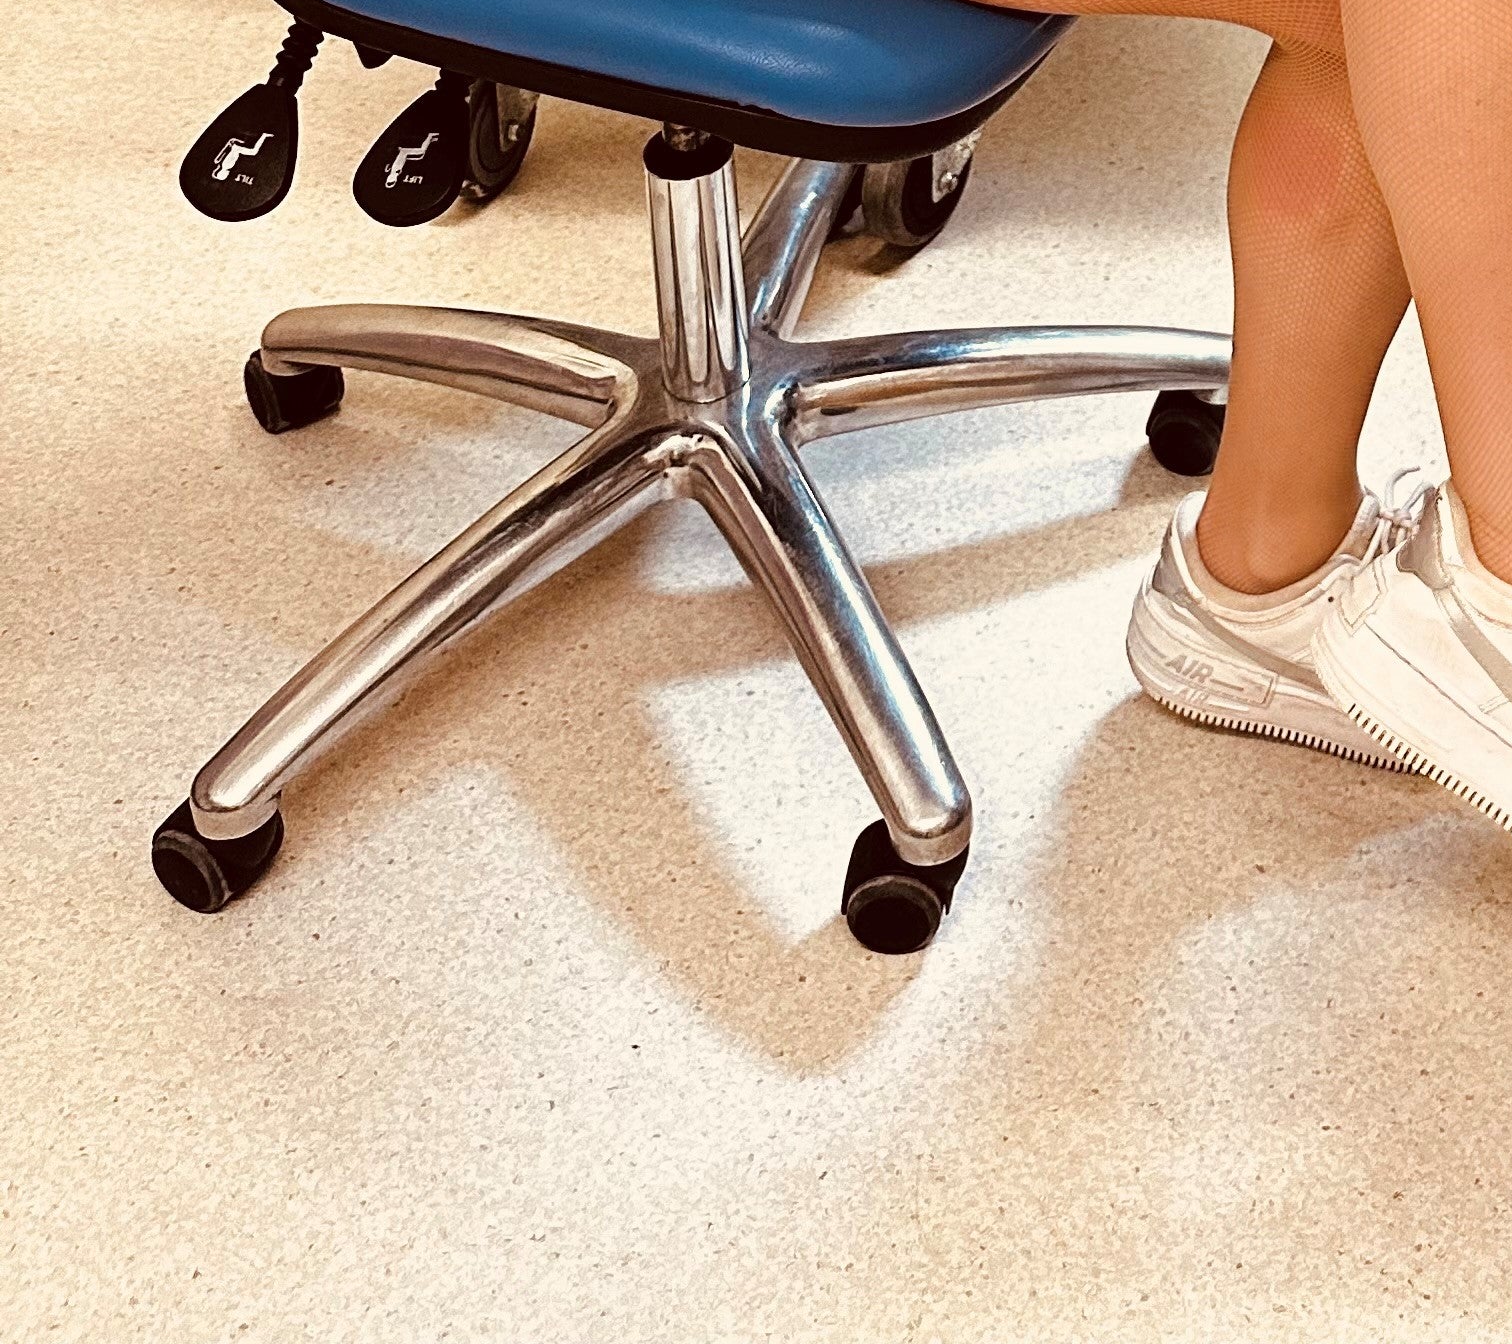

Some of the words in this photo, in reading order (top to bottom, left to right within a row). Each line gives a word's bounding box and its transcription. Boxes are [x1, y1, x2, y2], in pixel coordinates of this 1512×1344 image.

[235, 174, 254, 185] TILT
[403, 175, 423, 184] LIFT
[1165, 654, 1214, 683] AIR
